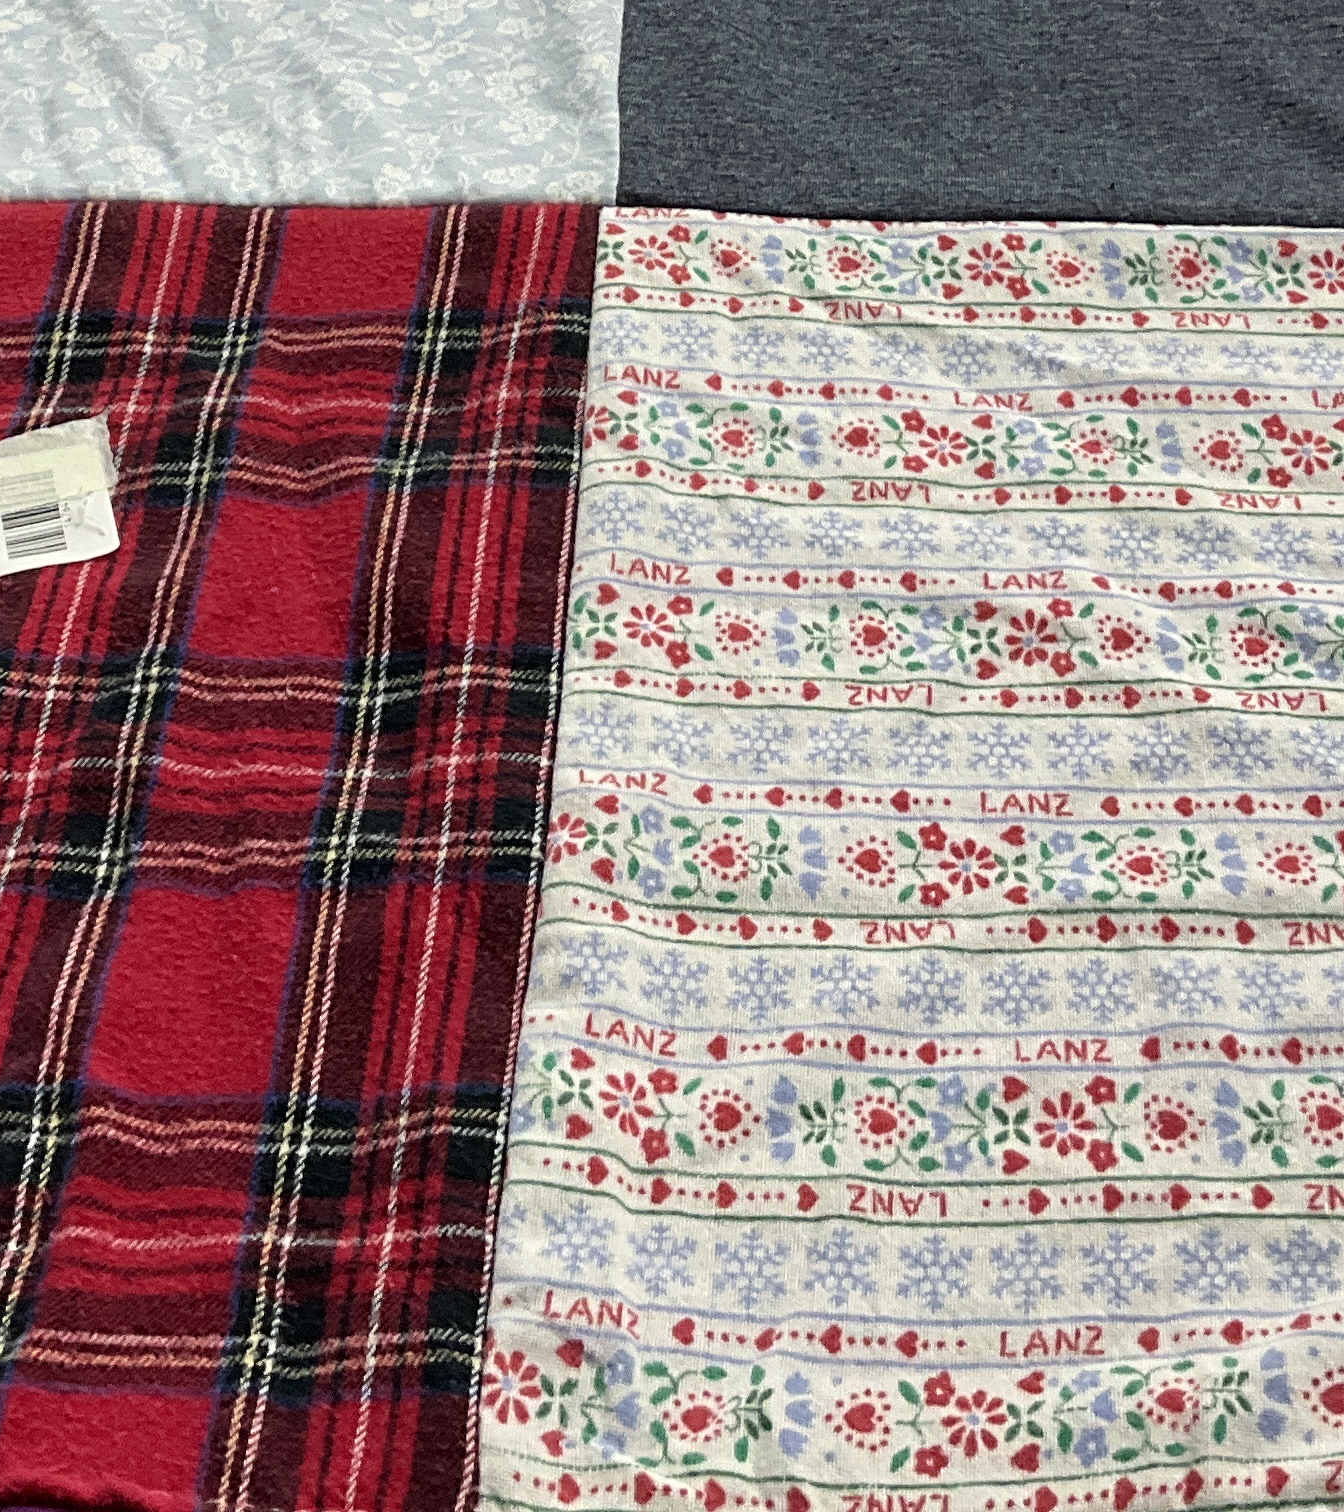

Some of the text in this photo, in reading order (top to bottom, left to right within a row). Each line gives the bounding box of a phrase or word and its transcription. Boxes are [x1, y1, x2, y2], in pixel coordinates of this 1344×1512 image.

[826, 302, 902, 320] LANZ
[1172, 312, 1250, 328] LANZ
[605, 366, 680, 389] LANZ
[954, 392, 1032, 411] LANZ
[853, 482, 930, 503] LANZ
[1220, 493, 1302, 510] LANZ
[610, 558, 690, 583] LANZ
[983, 570, 1066, 590] LANZ
[847, 684, 933, 706] LANZ
[1238, 692, 1327, 711] LANZ
[580, 771, 667, 794] LANZ
[980, 792, 1072, 816] LANZ
[862, 920, 956, 944] LANZ
[585, 1013, 677, 1054] LANZ
[1016, 1038, 1112, 1063] LANZ
[848, 1184, 948, 1217] LANZ
[543, 1290, 640, 1339] LANZ
[1000, 1329, 1104, 1358] LANZ
